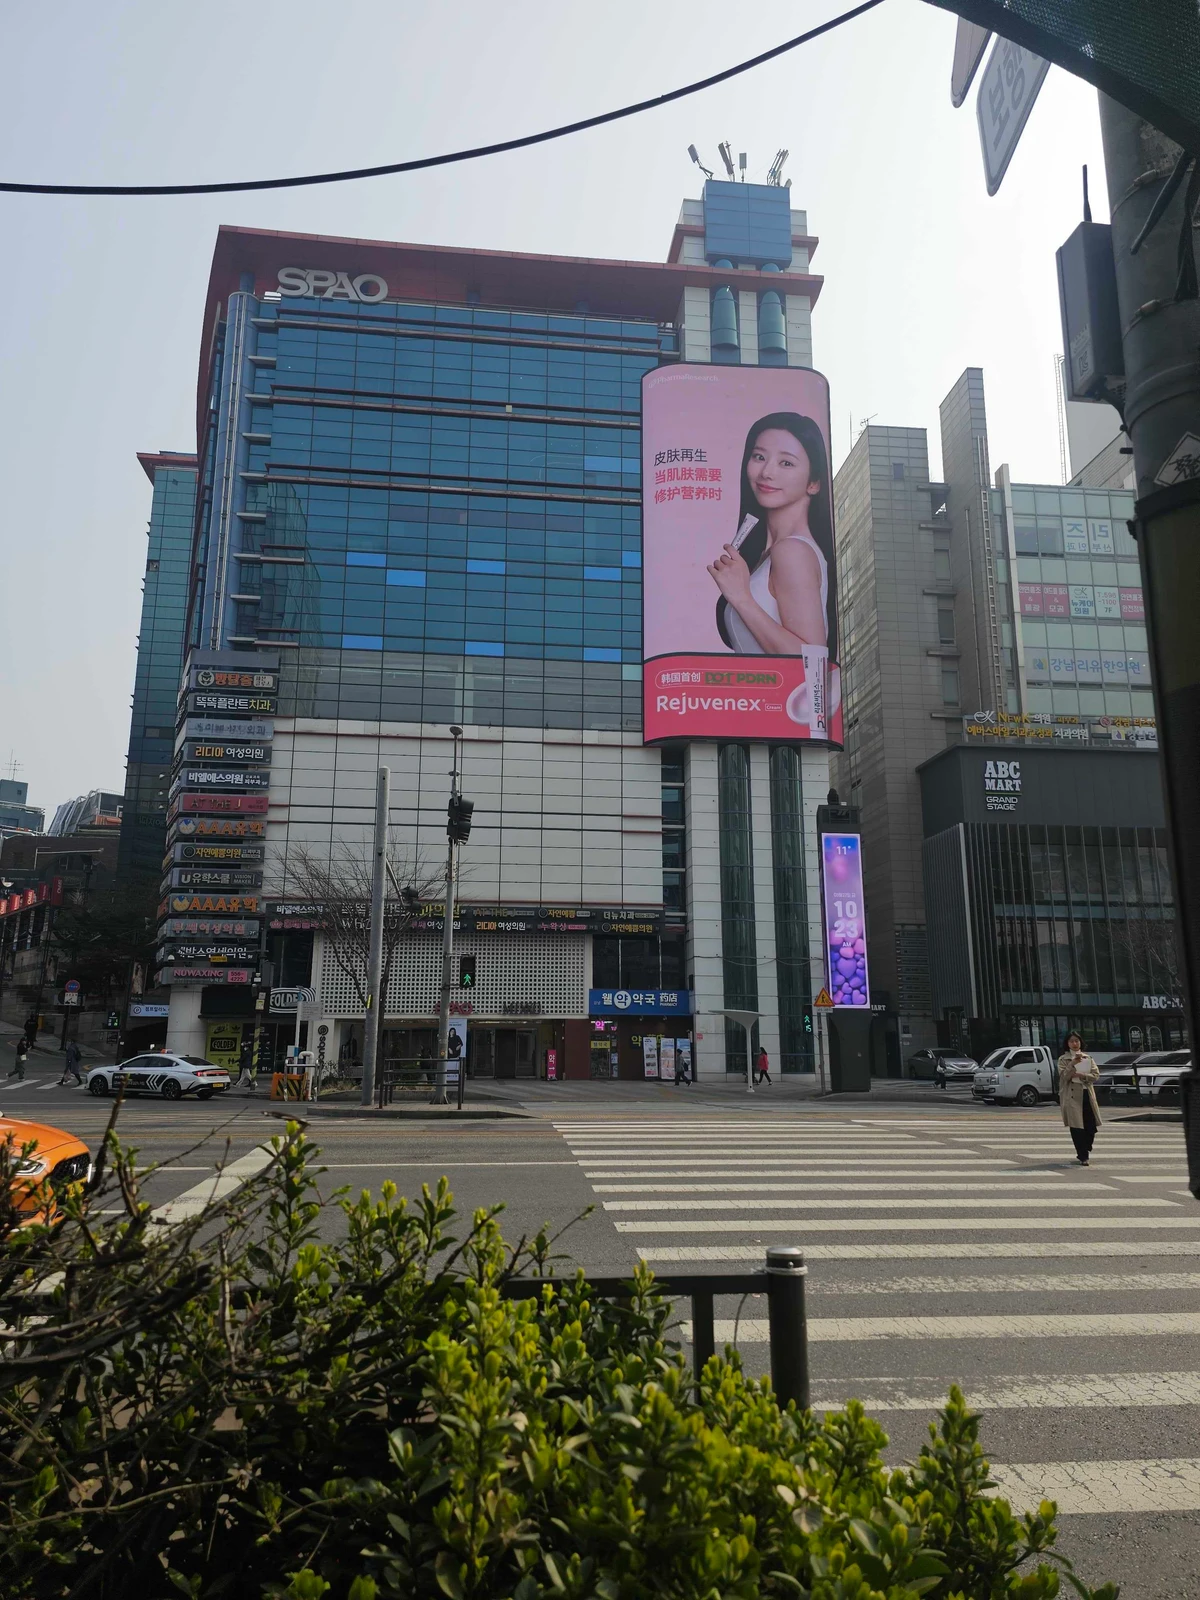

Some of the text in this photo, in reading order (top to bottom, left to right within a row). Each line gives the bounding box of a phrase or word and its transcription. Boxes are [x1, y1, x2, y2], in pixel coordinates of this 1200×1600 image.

[276, 267, 389, 303] SPAO
[654, 449, 708, 466] 皮肤再生
[655, 467, 722, 484] 当肌肤需要
[654, 486, 723, 504] 修护营养时
[1075, 607, 1090, 615] 의원
[661, 672, 701, 683] 韩国首创
[196, 696, 271, 711] 똑똑플란트치과
[657, 692, 761, 715] Rejuvenex
[1033, 713, 1052, 725] 의원
[1055, 728, 1089, 741] 치과의원
[196, 746, 264, 759] 리디아 여성의원
[984, 760, 1021, 779] ABC
[188, 772, 244, 784] 비엘에스의원
[984, 778, 1022, 792] MART
[986, 796, 1018, 804] GRAND
[986, 803, 1016, 811] STAGE
[189, 897, 258, 912] AAA유학
[833, 900, 858, 918] 10
[476, 921, 526, 931] 리디아 여성의원
[833, 920, 859, 943] 23
[173, 969, 224, 977] NUWAXING
[632, 992, 656, 1006] 약국
[659, 993, 678, 1003] 药店
[1142, 995, 1184, 1009] ABC-M
[631, 1035, 643, 1047] 약
